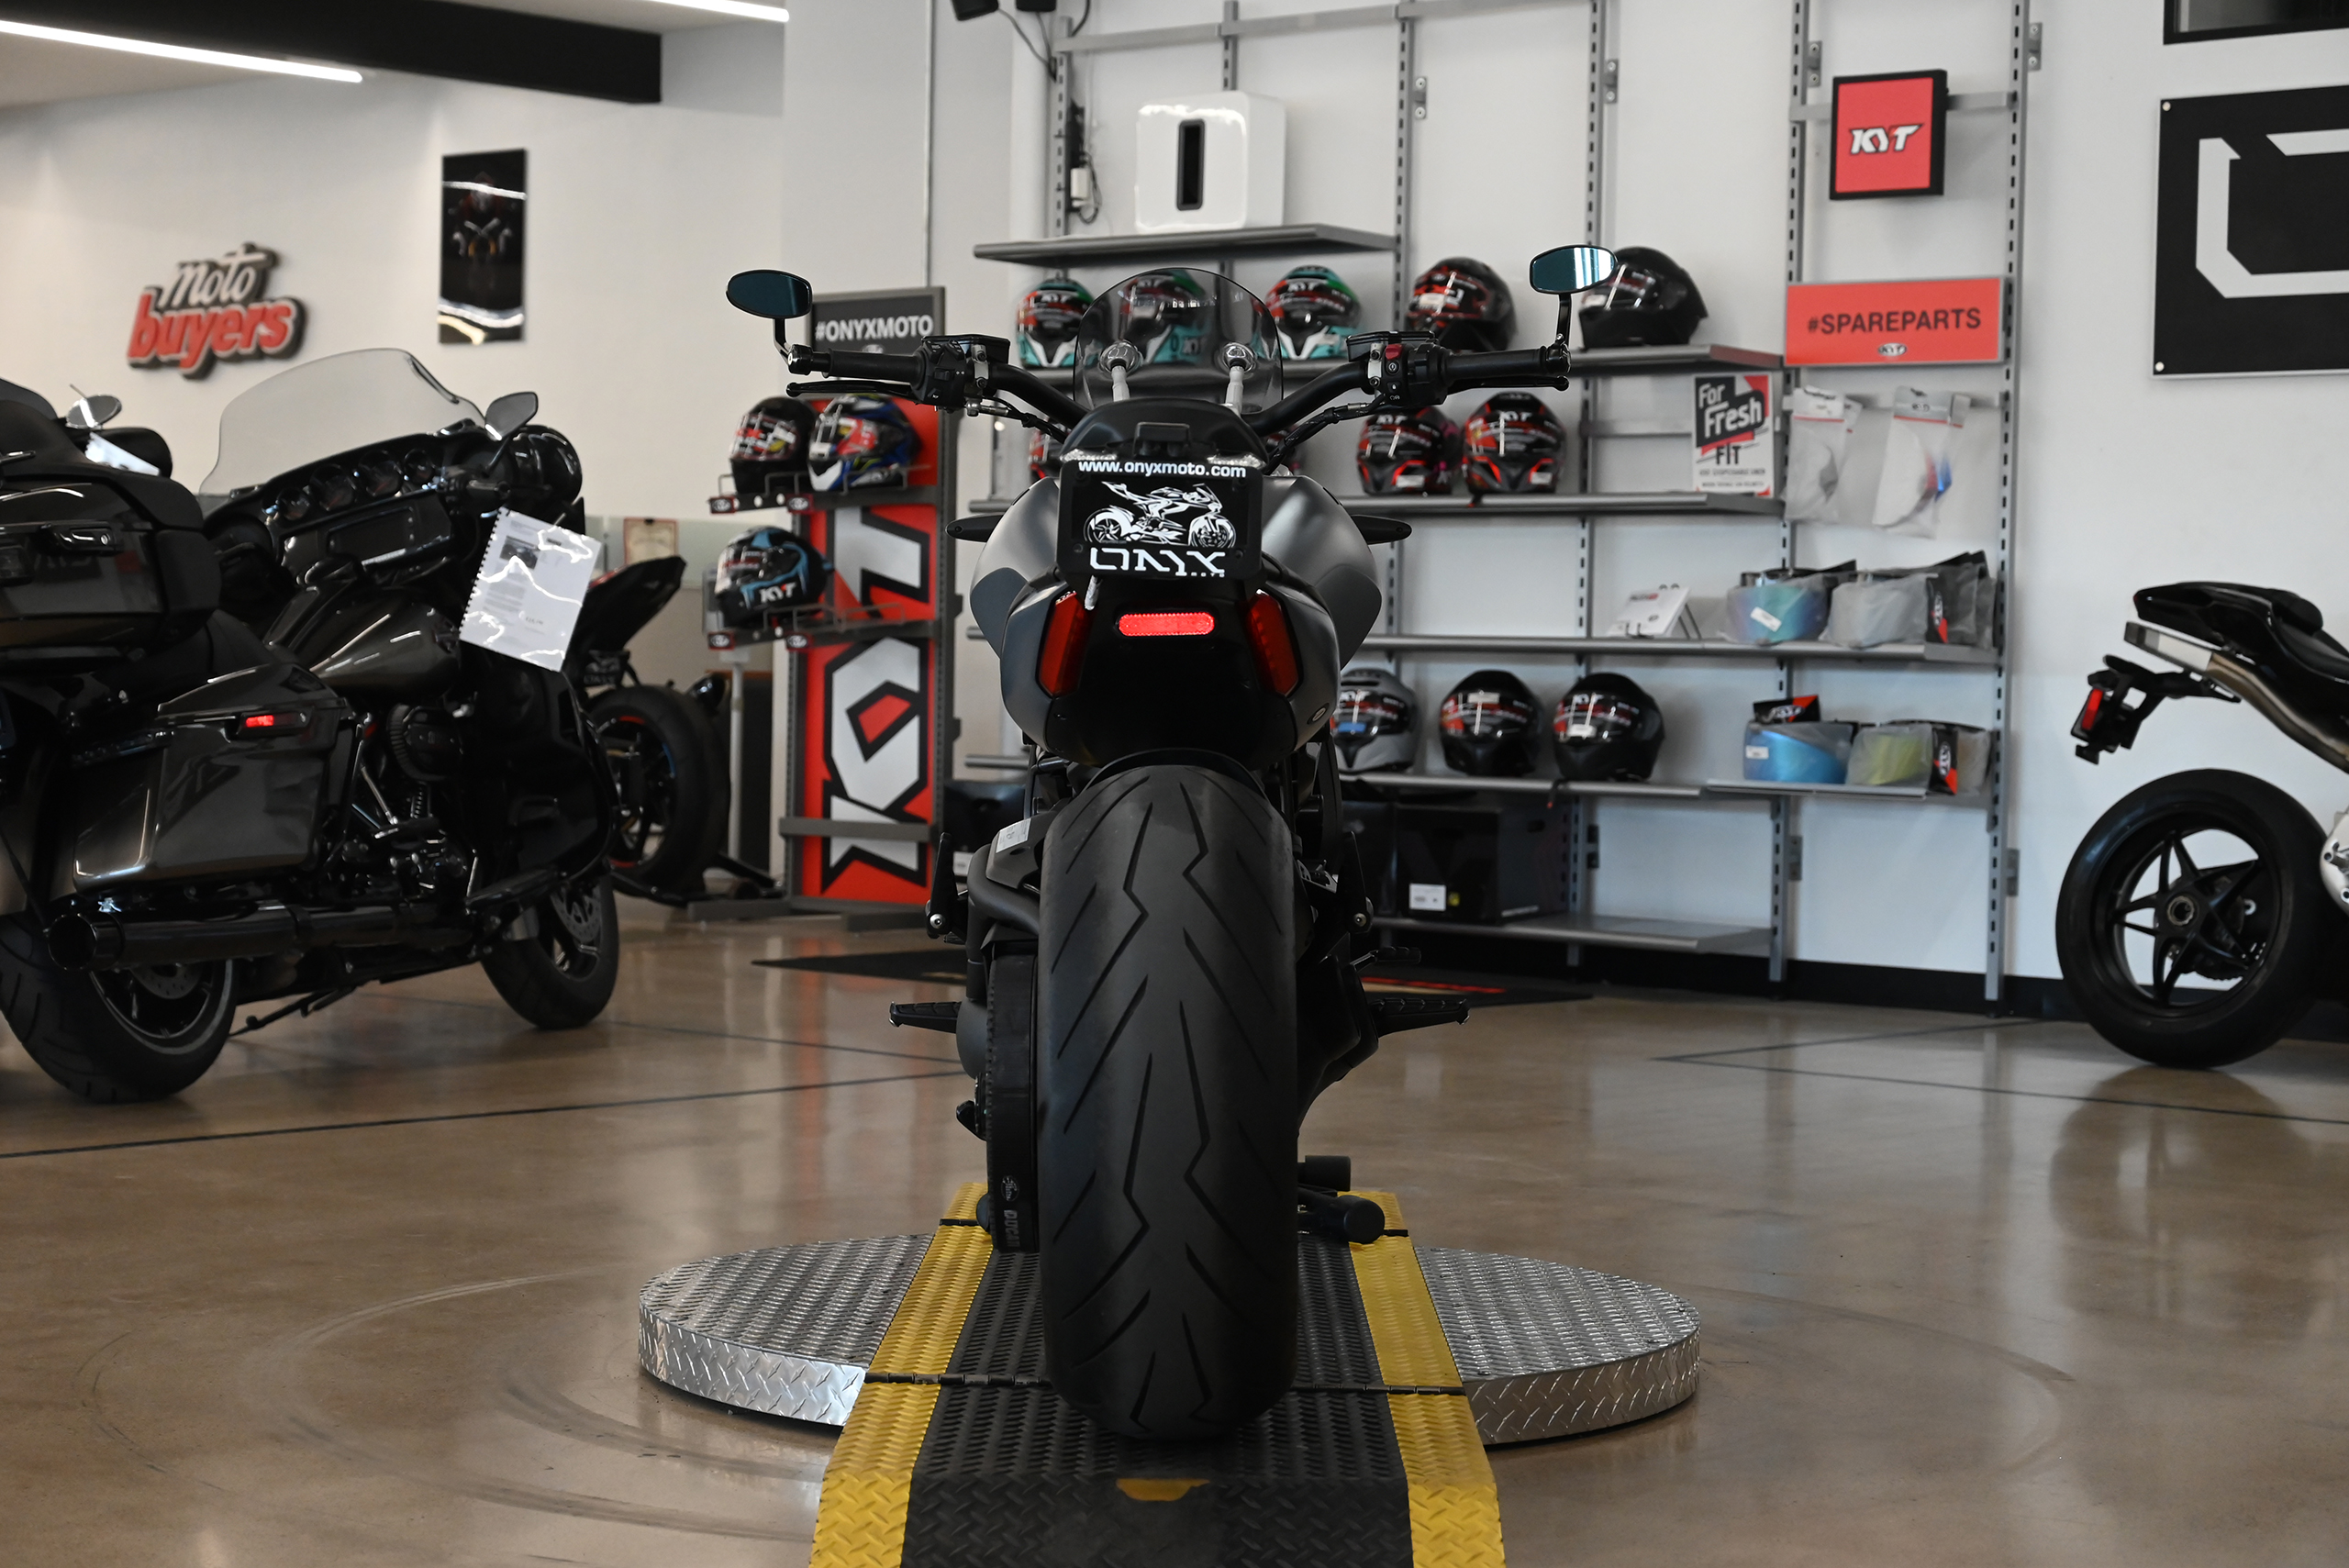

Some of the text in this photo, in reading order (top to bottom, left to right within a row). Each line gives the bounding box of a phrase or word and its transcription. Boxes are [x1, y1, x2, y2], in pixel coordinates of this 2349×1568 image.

[1849, 123, 1923, 155] KYT
[157, 244, 267, 309] Moto
[127, 290, 296, 372] buyers
[815, 314, 934, 342] #ONYXMOTO
[1807, 306, 1982, 335] #SPAREPARTS
[1698, 382, 1726, 409] For
[1704, 396, 1763, 439] Fresh
[1716, 442, 1742, 465] FIT
[1078, 461, 1247, 478] www.onyxmoto.com
[1089, 547, 1226, 577] ONYX
[759, 582, 796, 604] KYT
